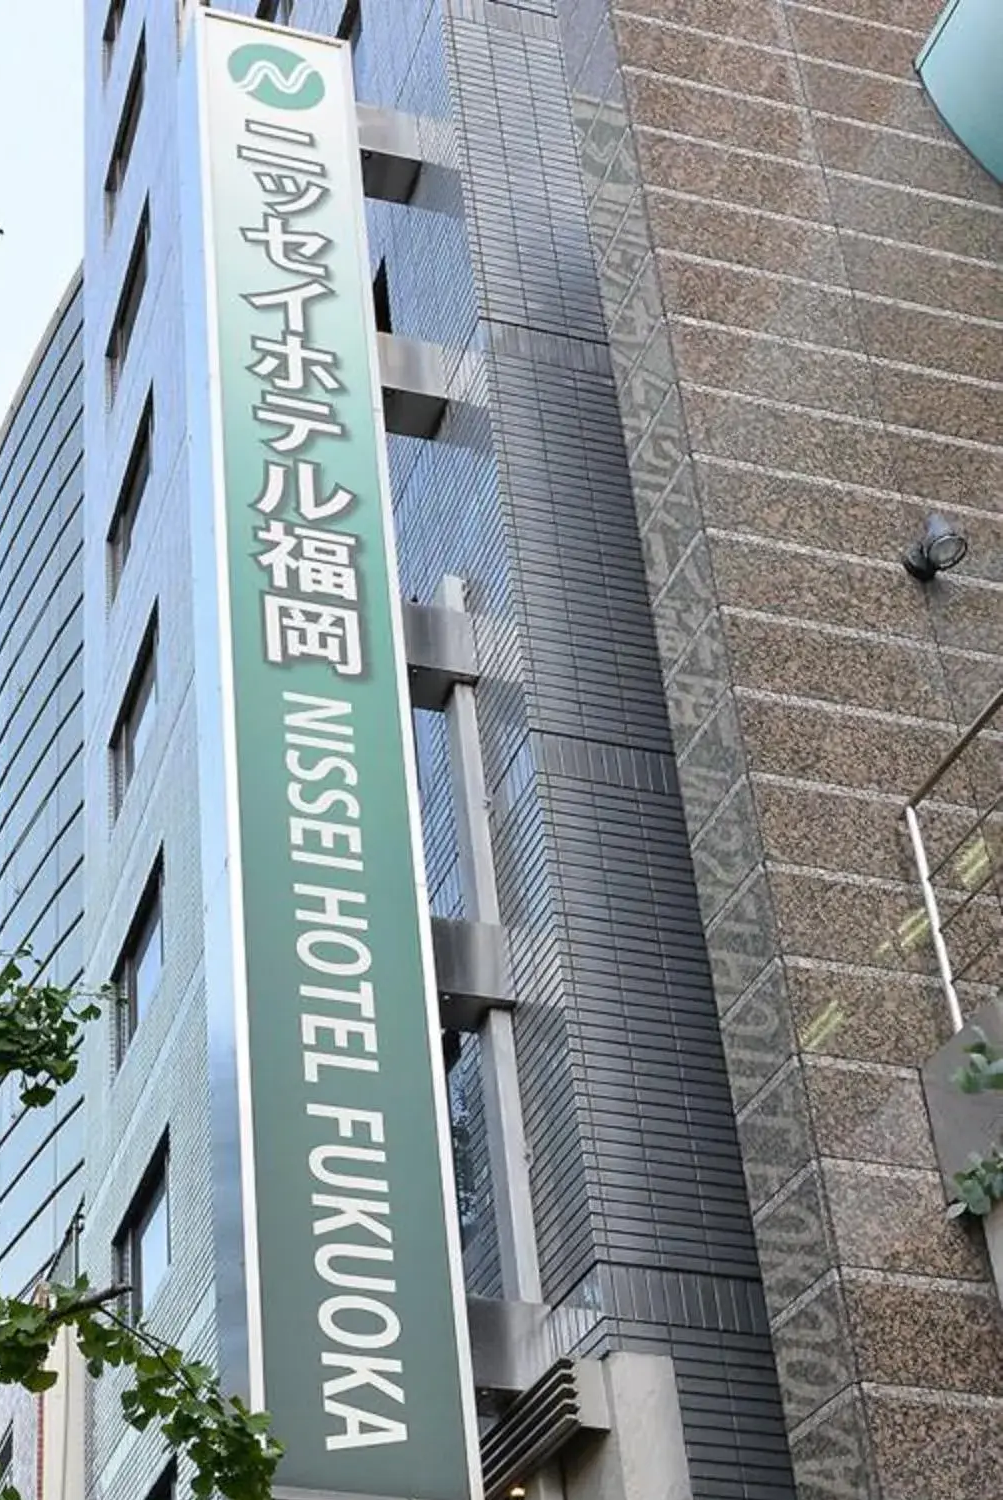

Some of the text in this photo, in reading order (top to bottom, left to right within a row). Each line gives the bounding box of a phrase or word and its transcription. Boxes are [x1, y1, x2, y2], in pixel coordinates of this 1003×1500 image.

[237, 119, 363, 677] ニッセイホテル福岡
[281, 691, 408, 1453] NISSEI HOTEL FUKUOKA
